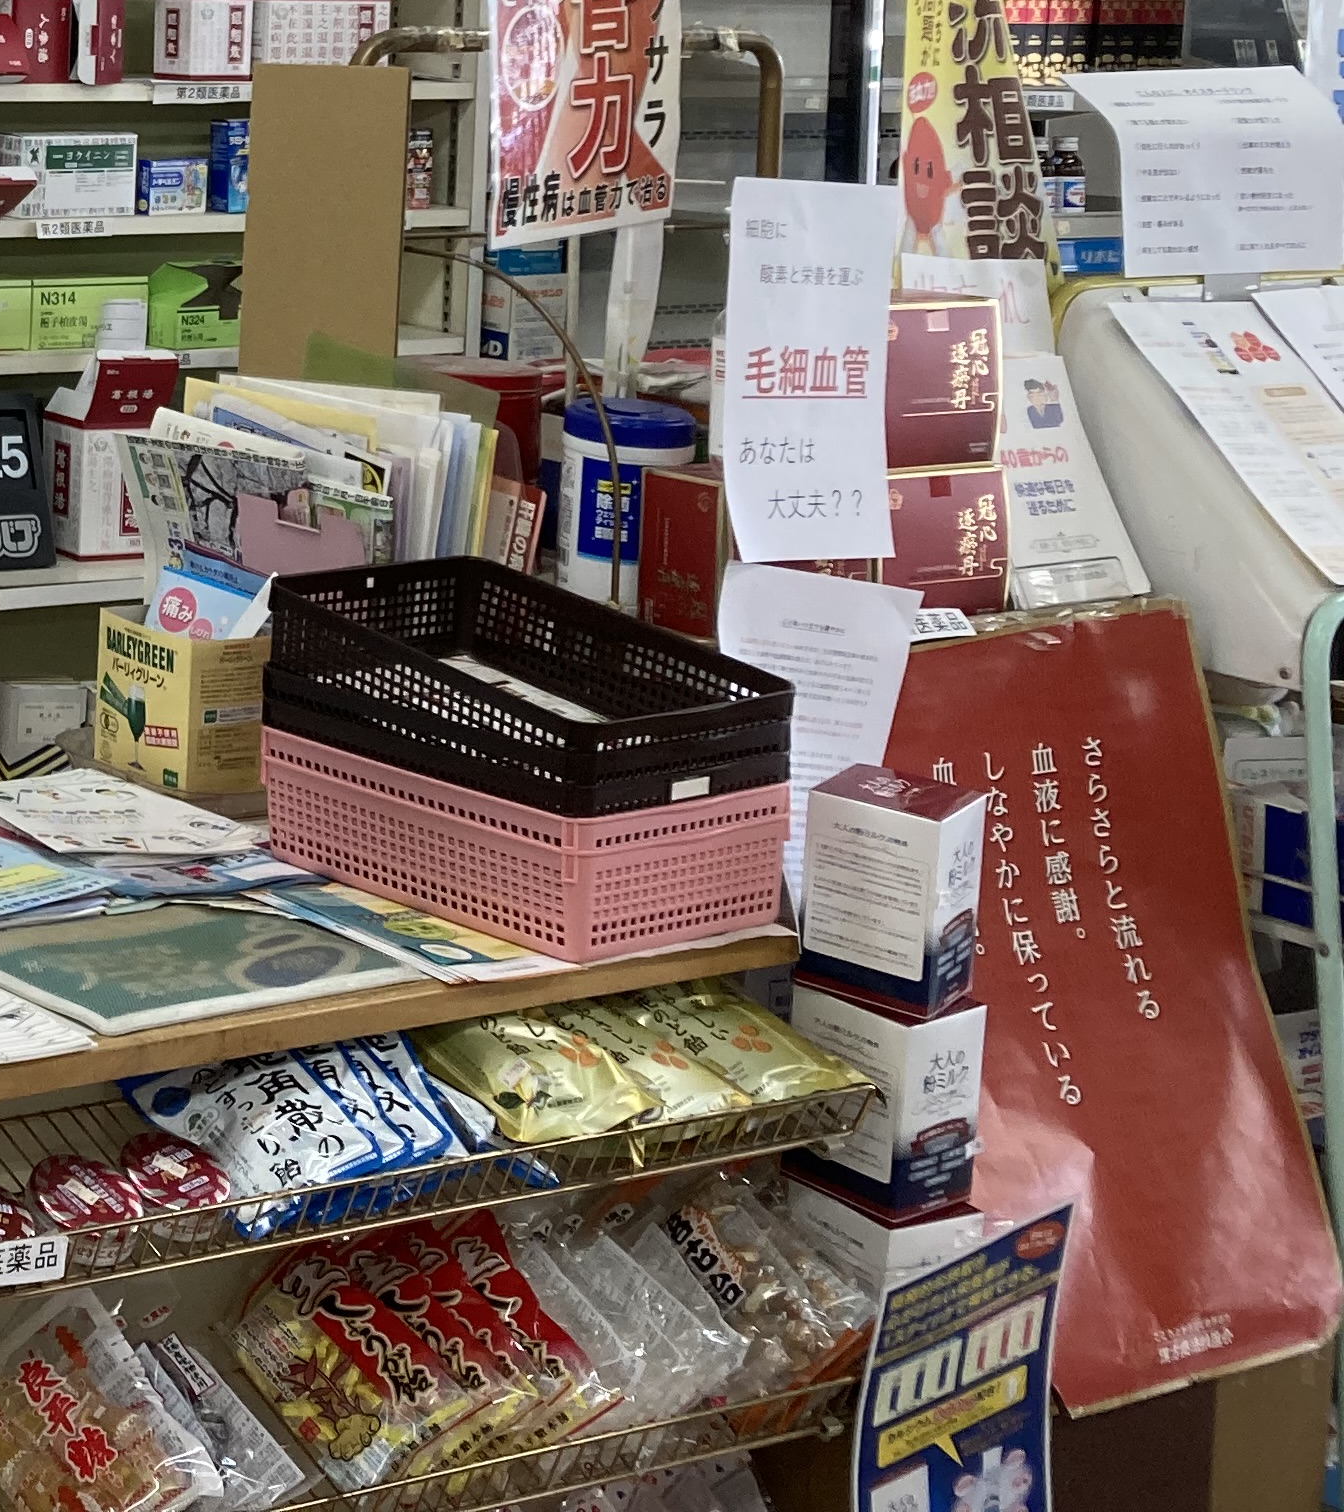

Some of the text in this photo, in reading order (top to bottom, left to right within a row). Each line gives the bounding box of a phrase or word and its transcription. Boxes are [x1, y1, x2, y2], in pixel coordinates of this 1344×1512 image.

[175, 86, 241, 102] 第2類医薬品
[501, 173, 669, 230] 慢性病は血管力で治る
[40, 221, 105, 238] 第2類医薬品
[39, 290, 77, 307] N314
[743, 345, 870, 398] 毛細血管
[738, 436, 816, 468] あなたは
[161, 596, 194, 624] 痛み
[1030, 741, 1088, 941] 血液に感謝。
[1080, 734, 1162, 1021] さらさらと流れる
[983, 749, 1084, 1109] しなやかに保っている
